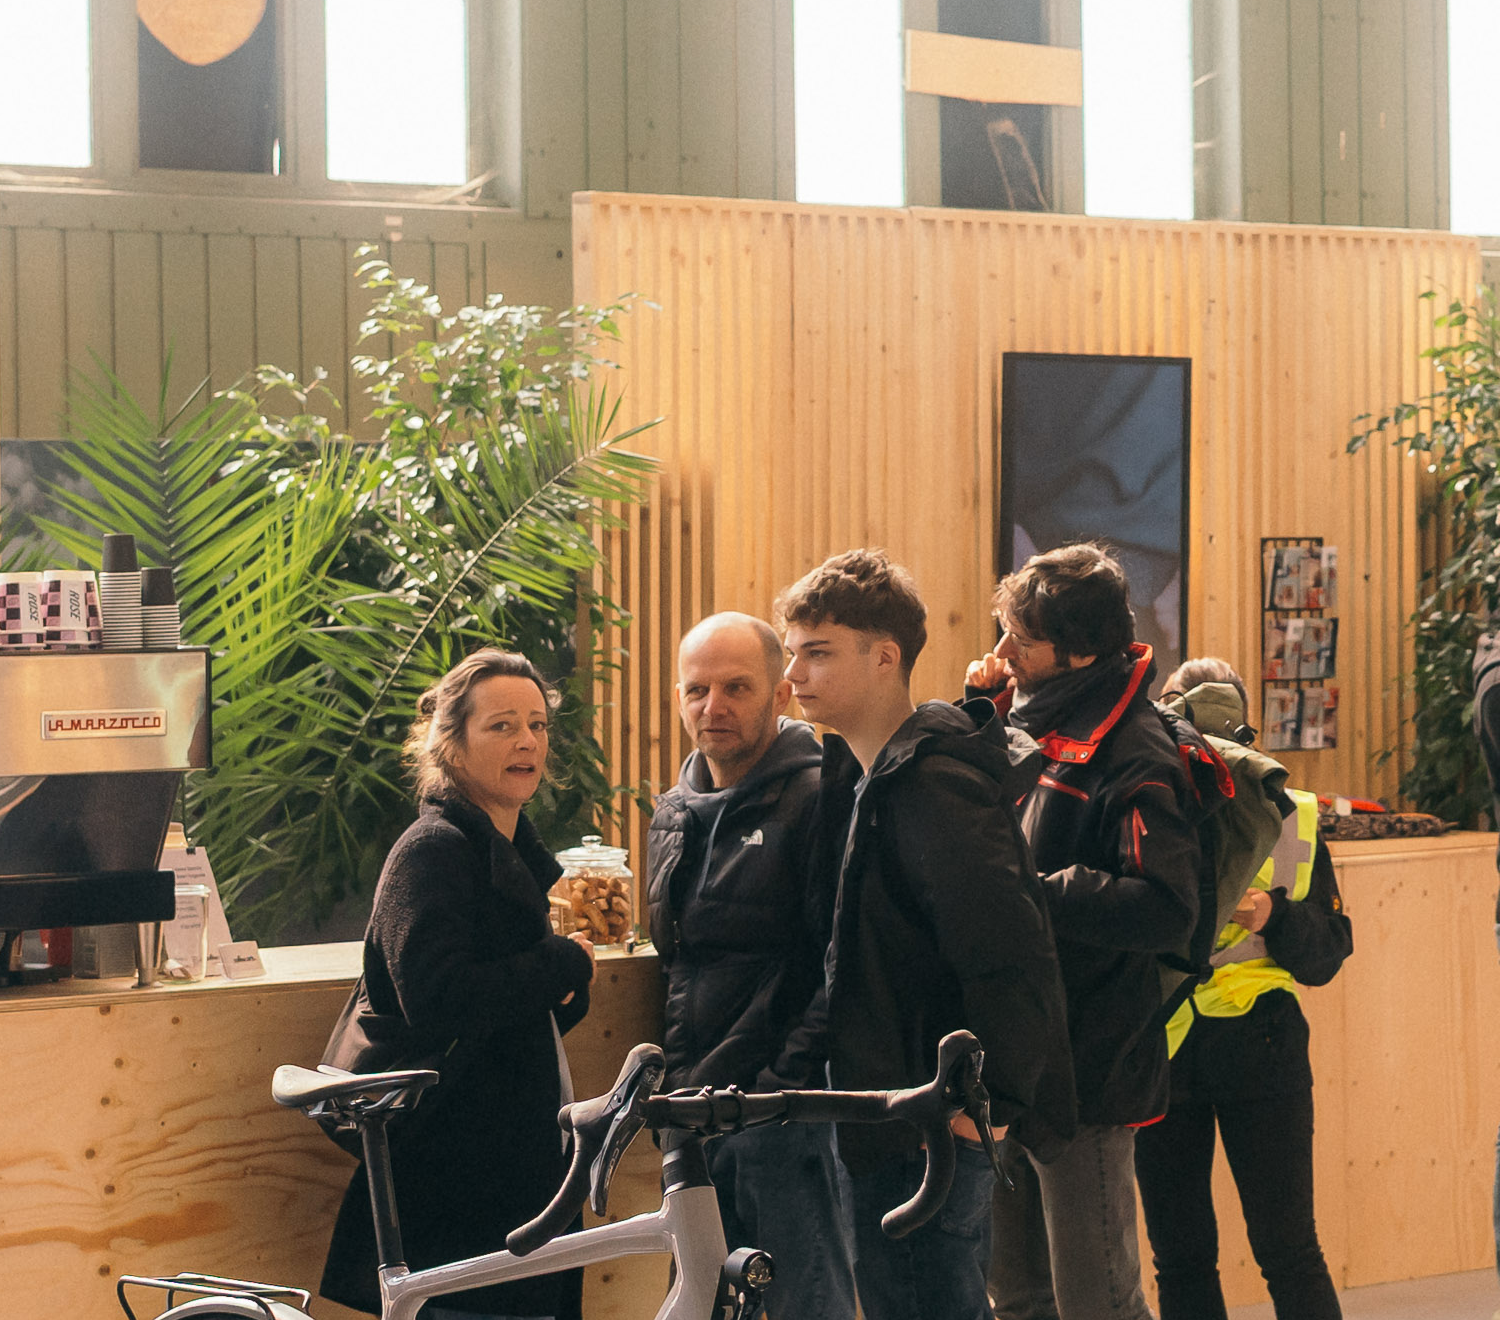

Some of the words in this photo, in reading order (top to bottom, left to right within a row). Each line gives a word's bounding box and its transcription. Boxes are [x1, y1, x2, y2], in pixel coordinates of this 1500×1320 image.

[28, 592, 40, 623] ROSE
[69, 589, 81, 622] ROSE
[48, 719, 64, 731] LA
[70, 717, 161, 730] MARZOCCO
